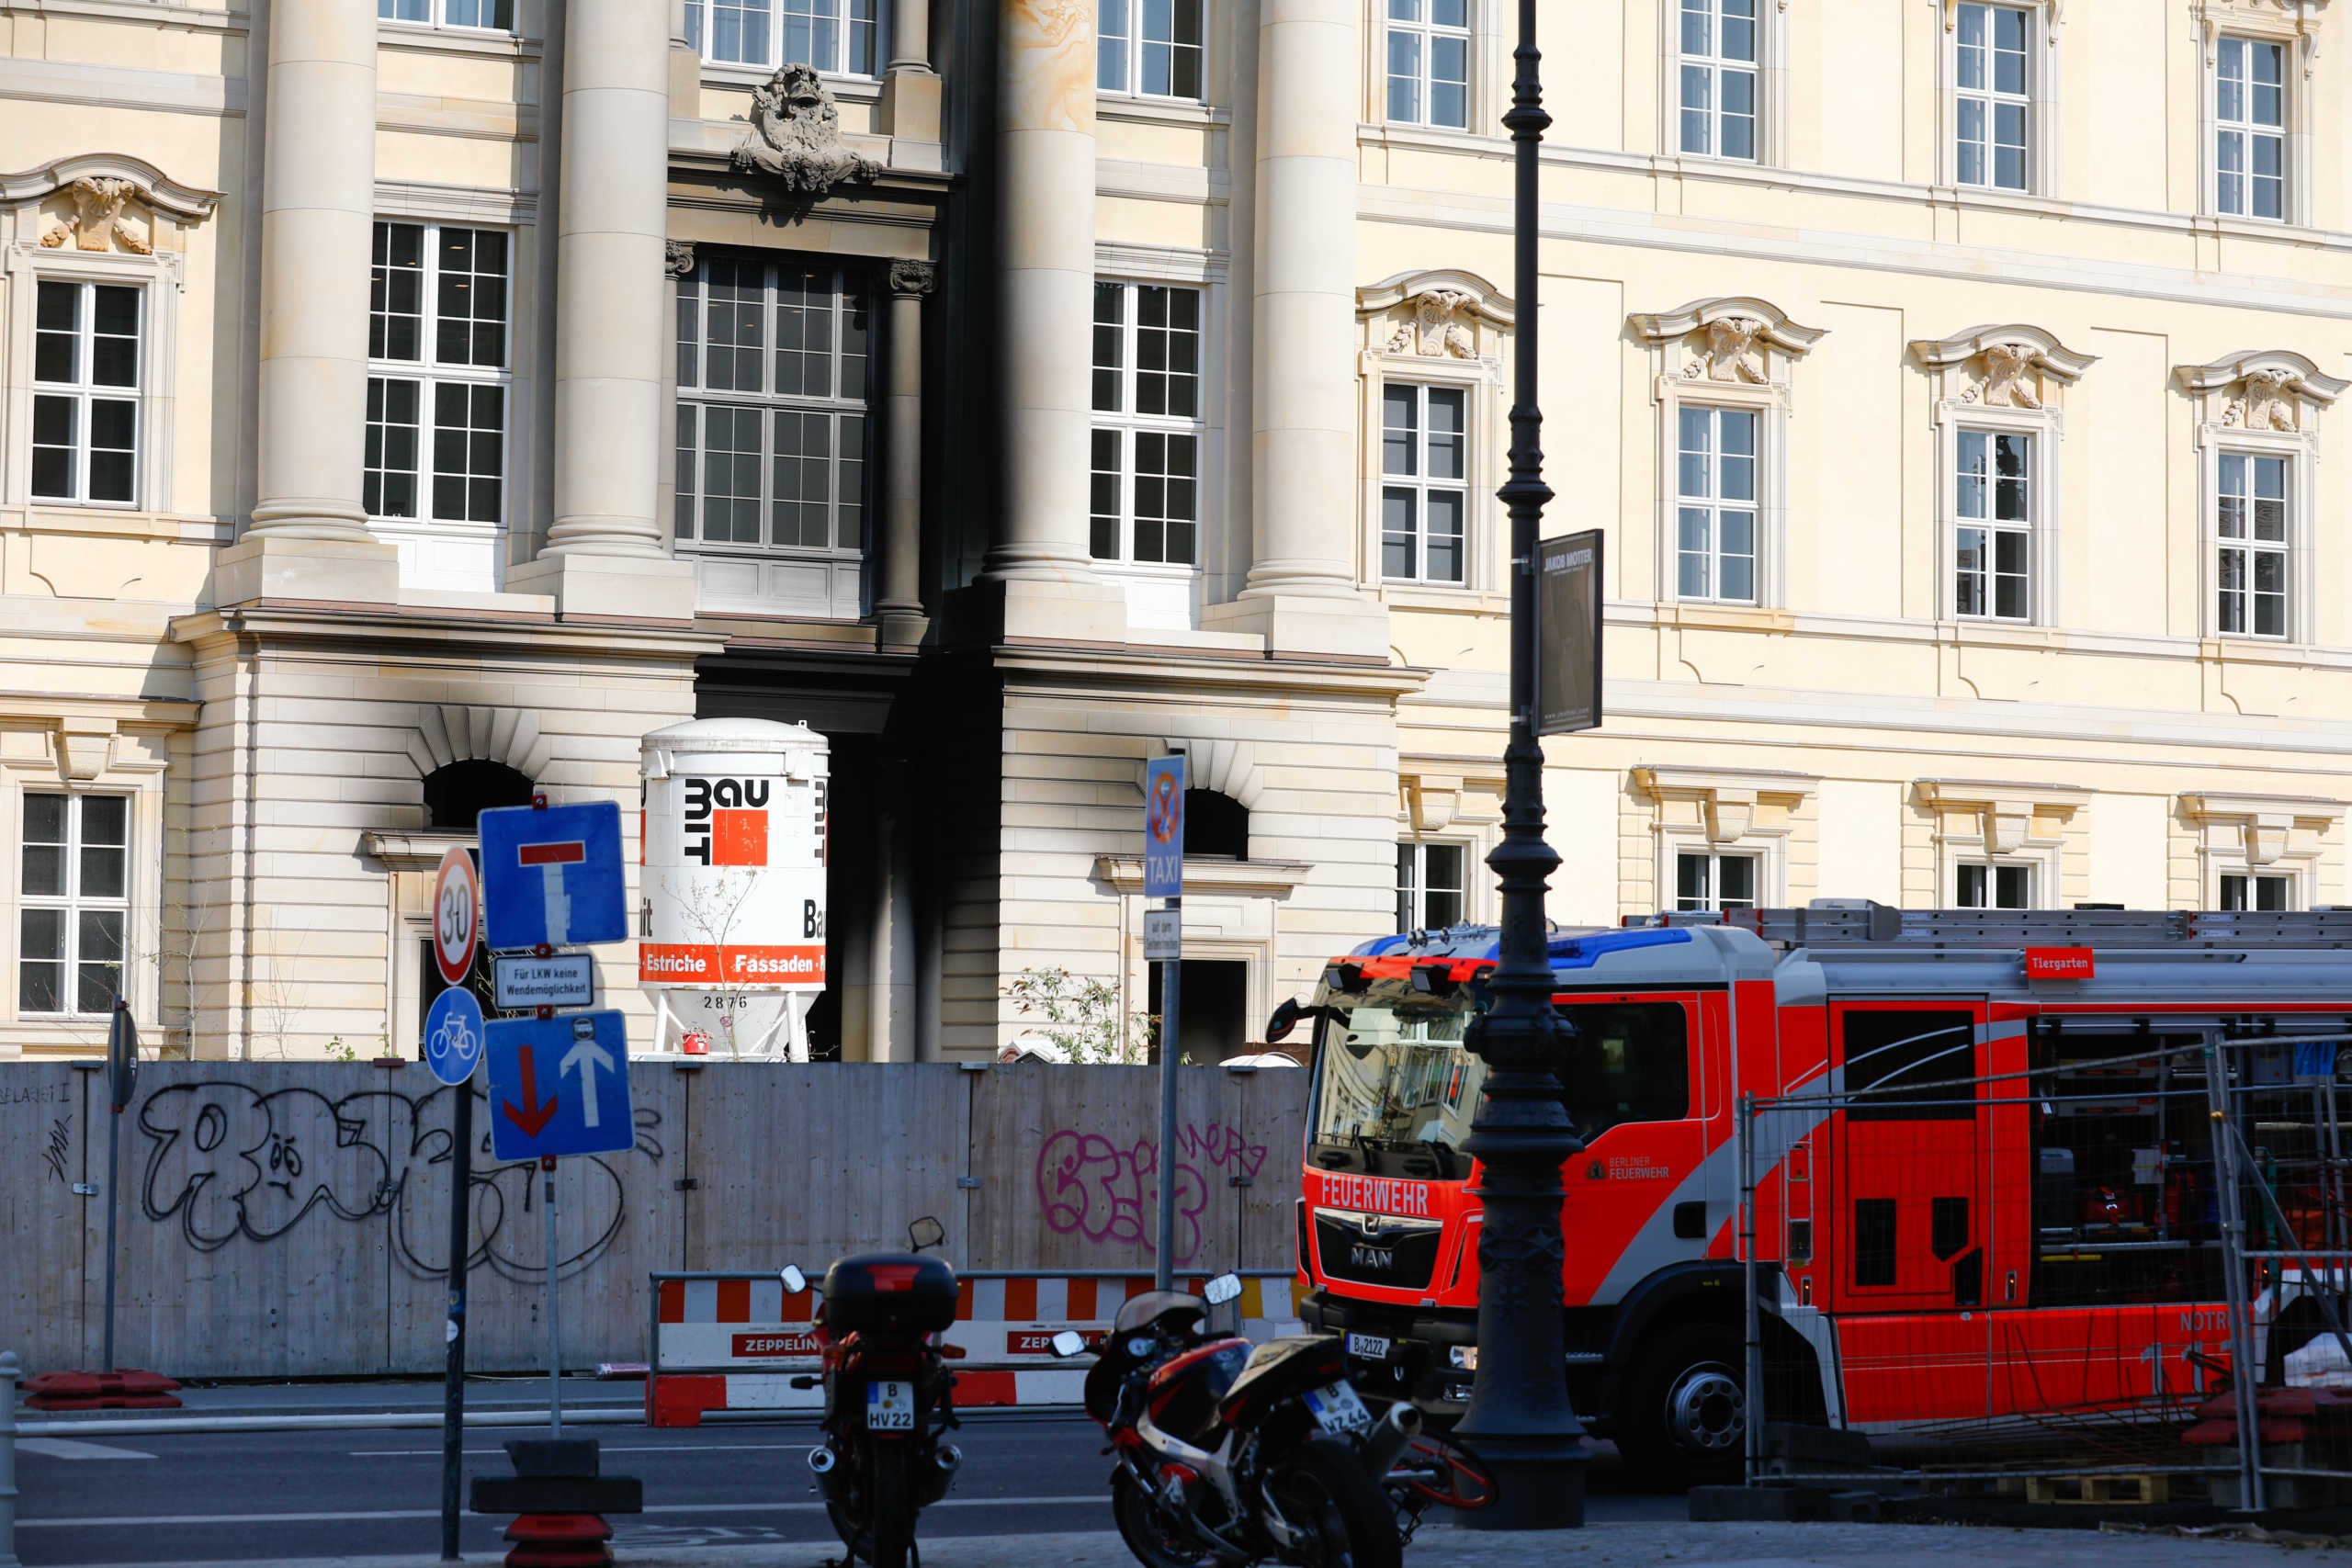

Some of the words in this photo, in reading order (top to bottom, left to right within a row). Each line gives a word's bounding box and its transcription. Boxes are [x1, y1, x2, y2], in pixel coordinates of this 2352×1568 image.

[1148, 856, 1179, 885] TAXI
[442, 883, 468, 944] 30
[647, 953, 707, 974] Estriche
[735, 954, 813, 974] Fassaden
[2031, 956, 2088, 971] Tiergarten
[514, 968, 529, 980] Für
[532, 968, 551, 980] LKW
[554, 967, 578, 978] keine
[506, 982, 586, 997] Wendemöglichkeit
[704, 996, 747, 1010] 2876
[1609, 1156, 1650, 1168] BERLINER
[1610, 1167, 1669, 1179] FEUERWEHR
[1322, 1174, 1429, 1215] FEUERWEHR
[1351, 1247, 1393, 1268] MAN
[2180, 1311, 2233, 1331] NOTR
[745, 1338, 817, 1352] ZEPPELIN
[1354, 1337, 1360, 1352] B
[888, 1382, 898, 1397] B
[869, 1412, 889, 1427] HV
[892, 1412, 911, 1427] 22
